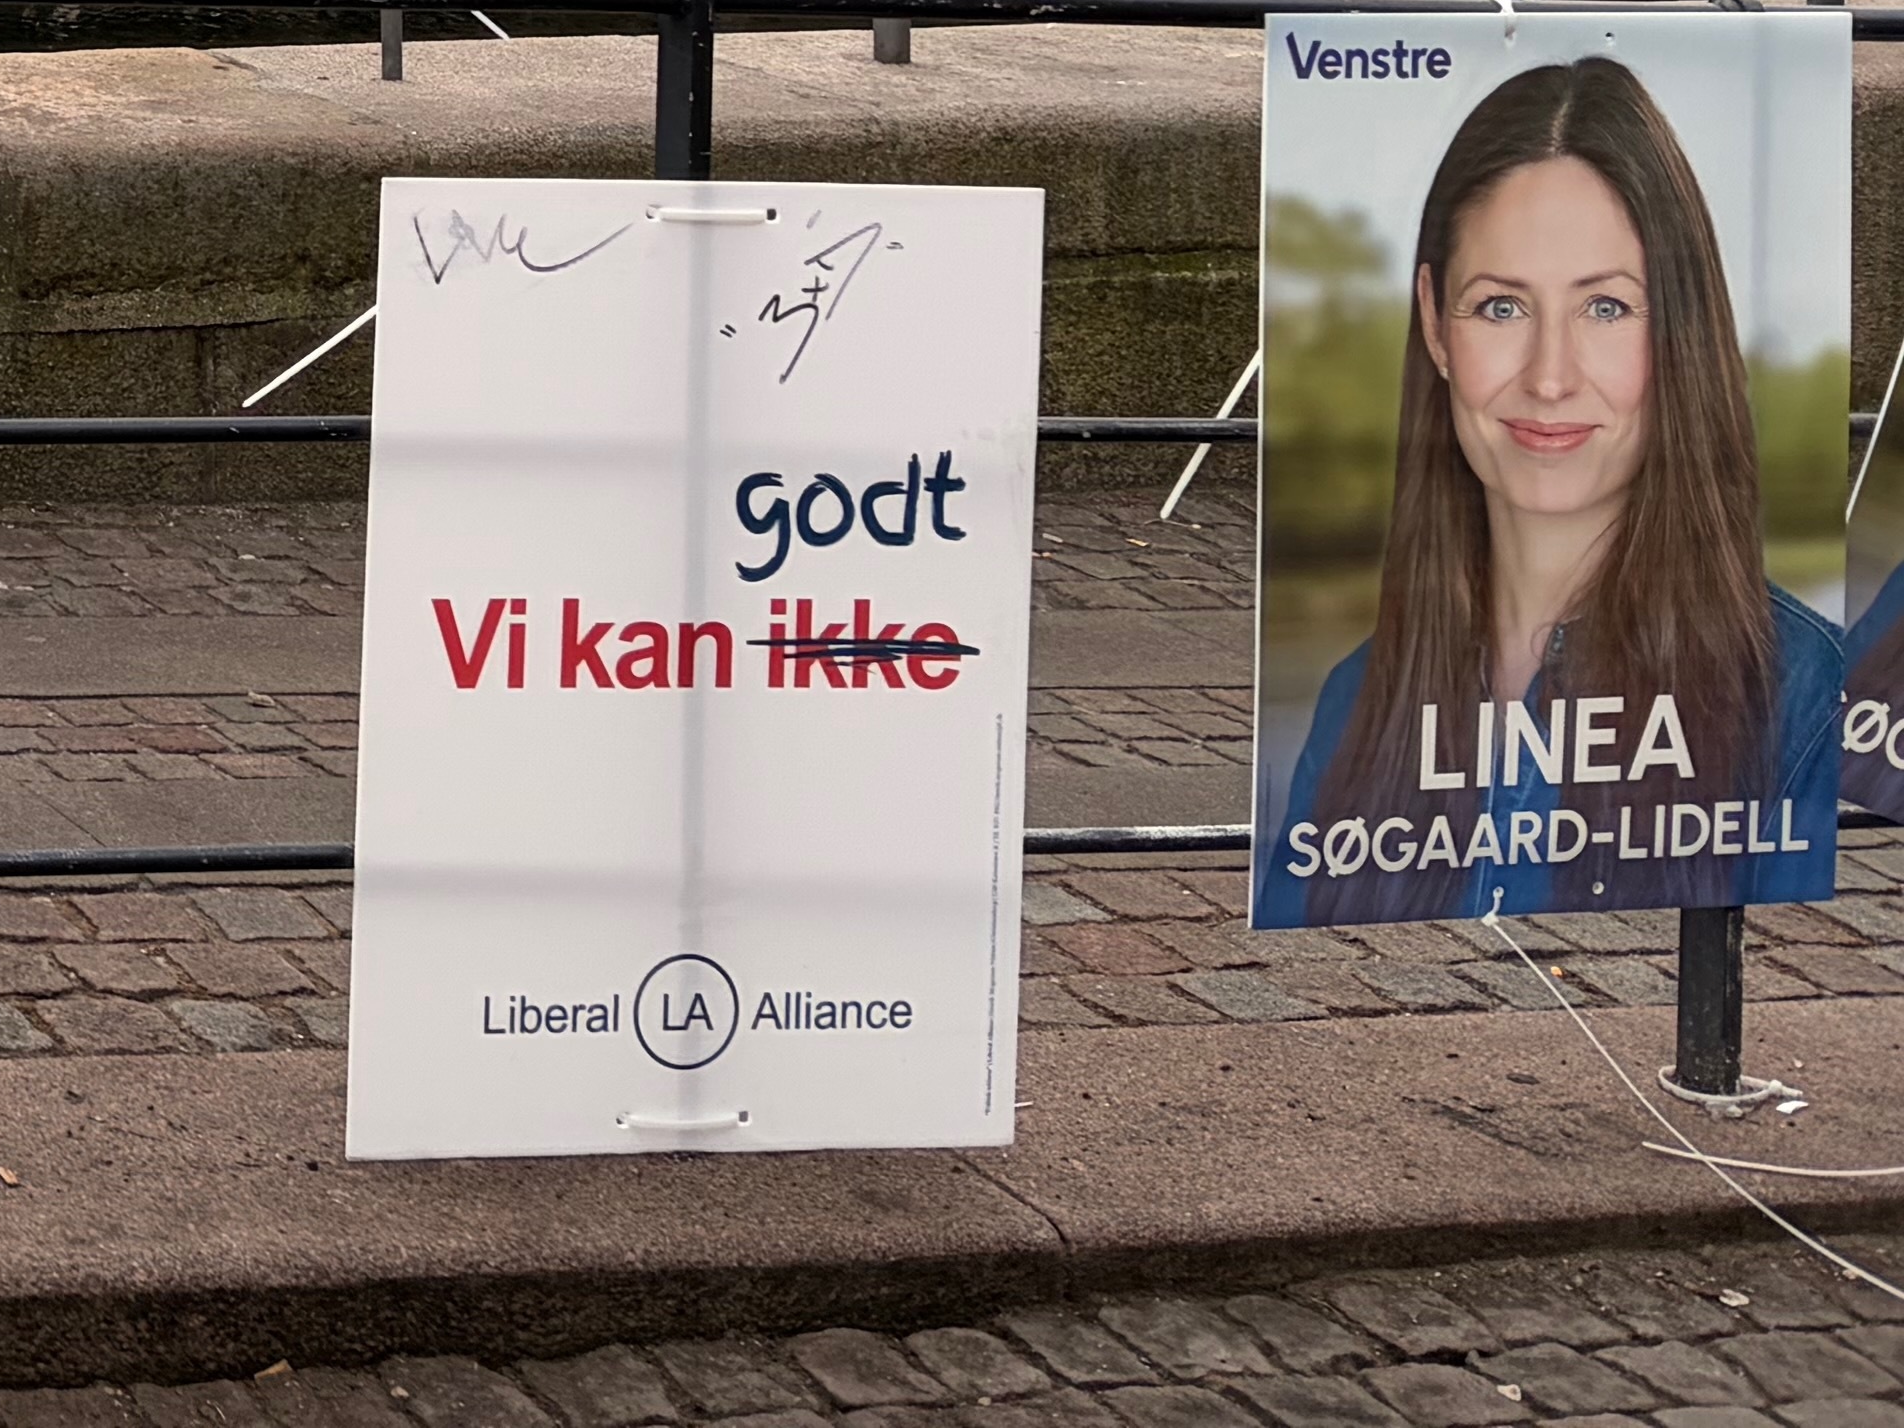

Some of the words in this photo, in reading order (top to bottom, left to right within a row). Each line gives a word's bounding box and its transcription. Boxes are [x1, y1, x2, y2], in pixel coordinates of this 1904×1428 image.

[1286, 32, 1451, 79] Venstre
[735, 450, 966, 582] godt
[433, 599, 527, 690] Vi
[560, 598, 733, 690] kan
[769, 599, 960, 690] ikke
[1420, 695, 1694, 789] LINEA
[1288, 800, 1808, 877] SØGAARD-LIDELL
[484, 994, 619, 1034] Liberal
[663, 993, 713, 1031] LA
[751, 992, 912, 1030] Alliance
